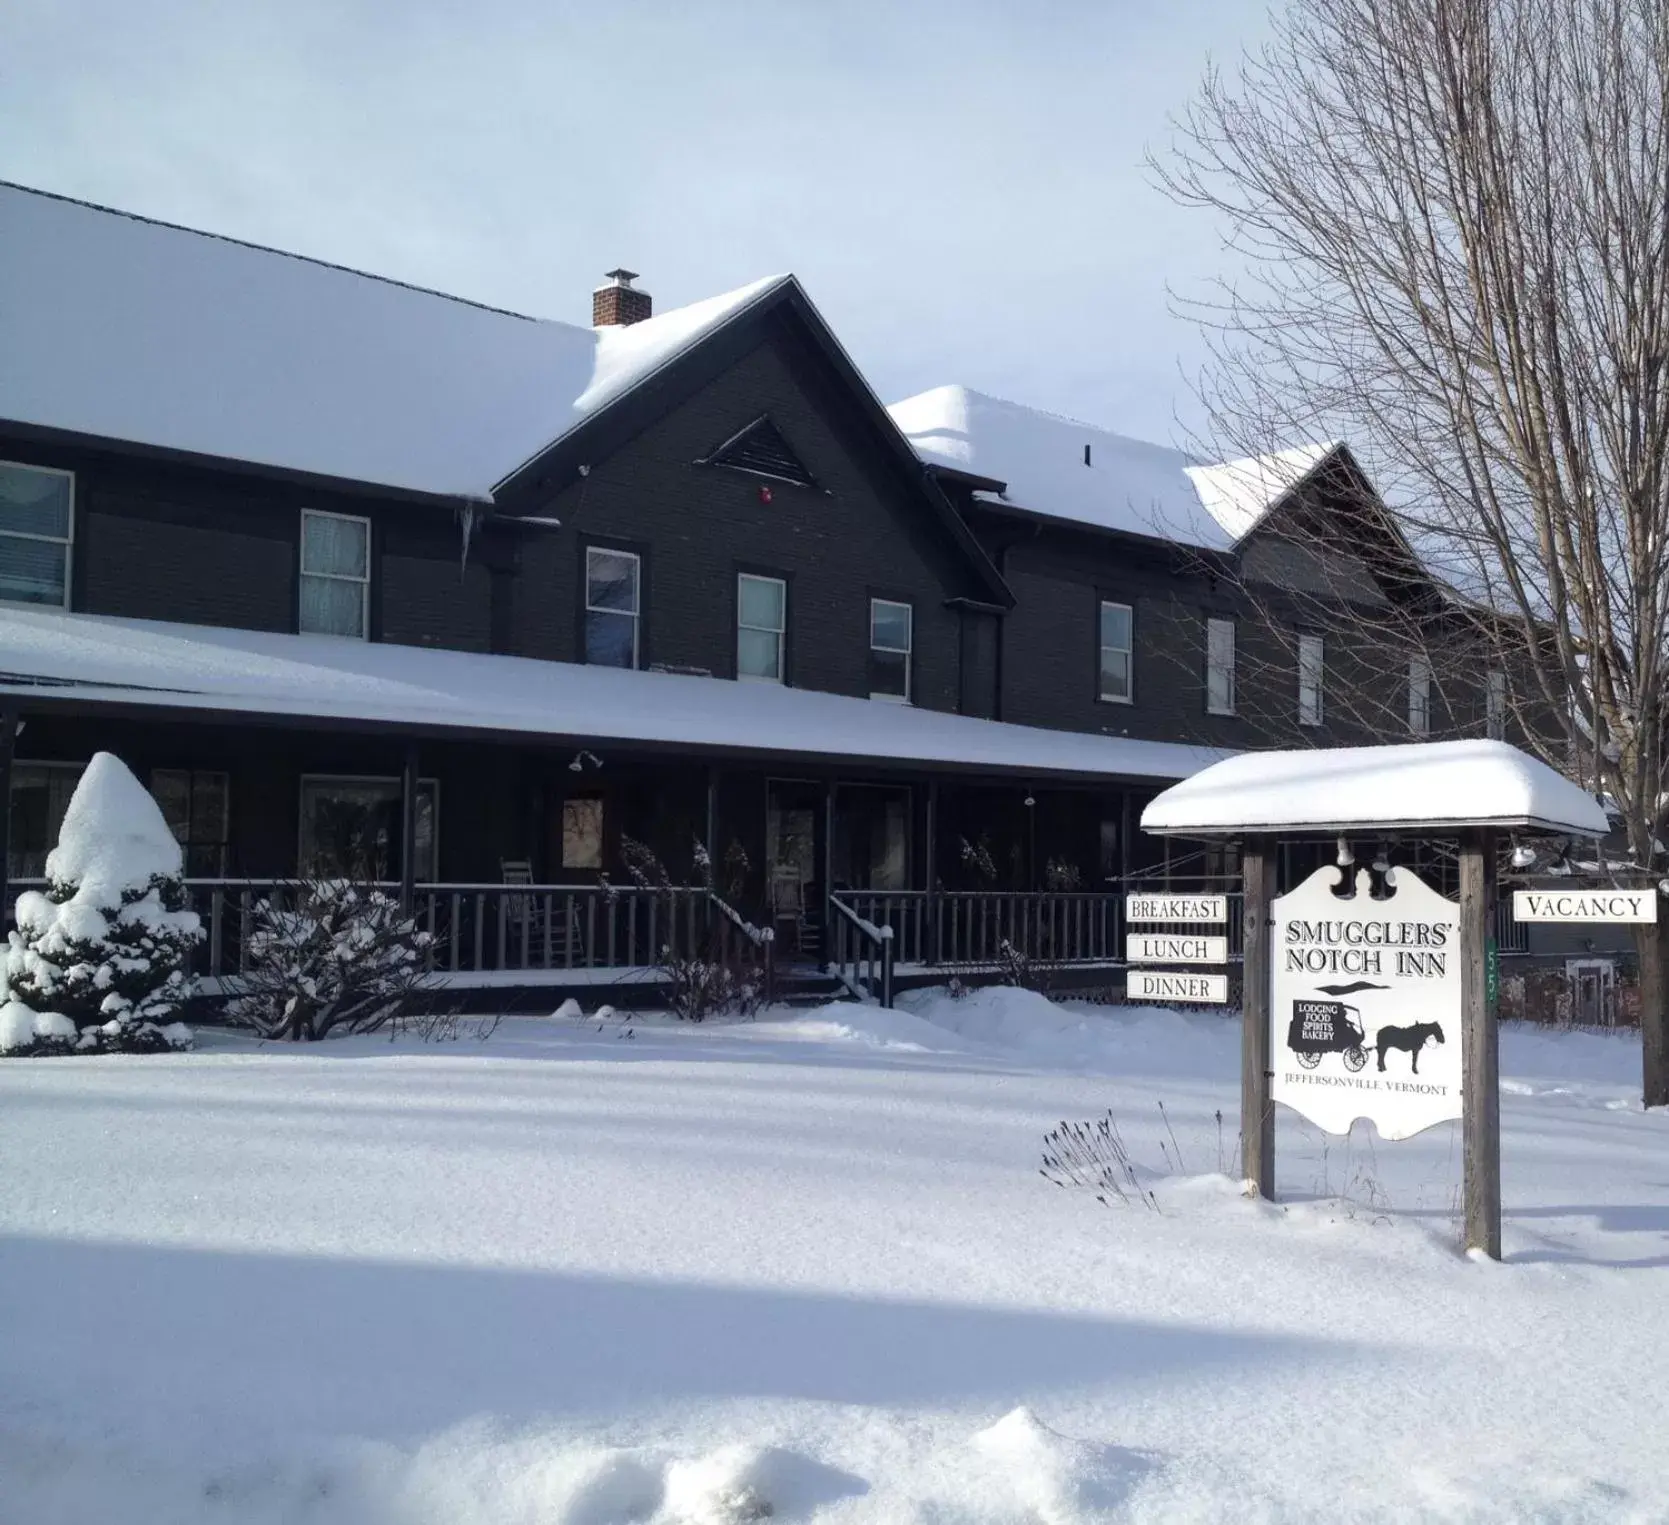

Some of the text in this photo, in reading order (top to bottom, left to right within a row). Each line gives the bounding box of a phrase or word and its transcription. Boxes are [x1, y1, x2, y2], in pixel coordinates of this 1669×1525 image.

[1132, 900, 1220, 918] BREAKFAST
[1526, 896, 1643, 917] VACANCY
[1286, 920, 1452, 947] SMUGGLERS'
[1143, 940, 1208, 959] LUNCH
[1286, 949, 1447, 977] NOTCH INN
[1143, 977, 1210, 997] DINNER
[1298, 1003, 1338, 1014] LODGING
[1305, 1013, 1331, 1022] FOOD
[1302, 1030, 1334, 1040] BAKERY
[1303, 1021, 1334, 1031] SPIRITS
[1386, 1081, 1448, 1096] VERMONT
